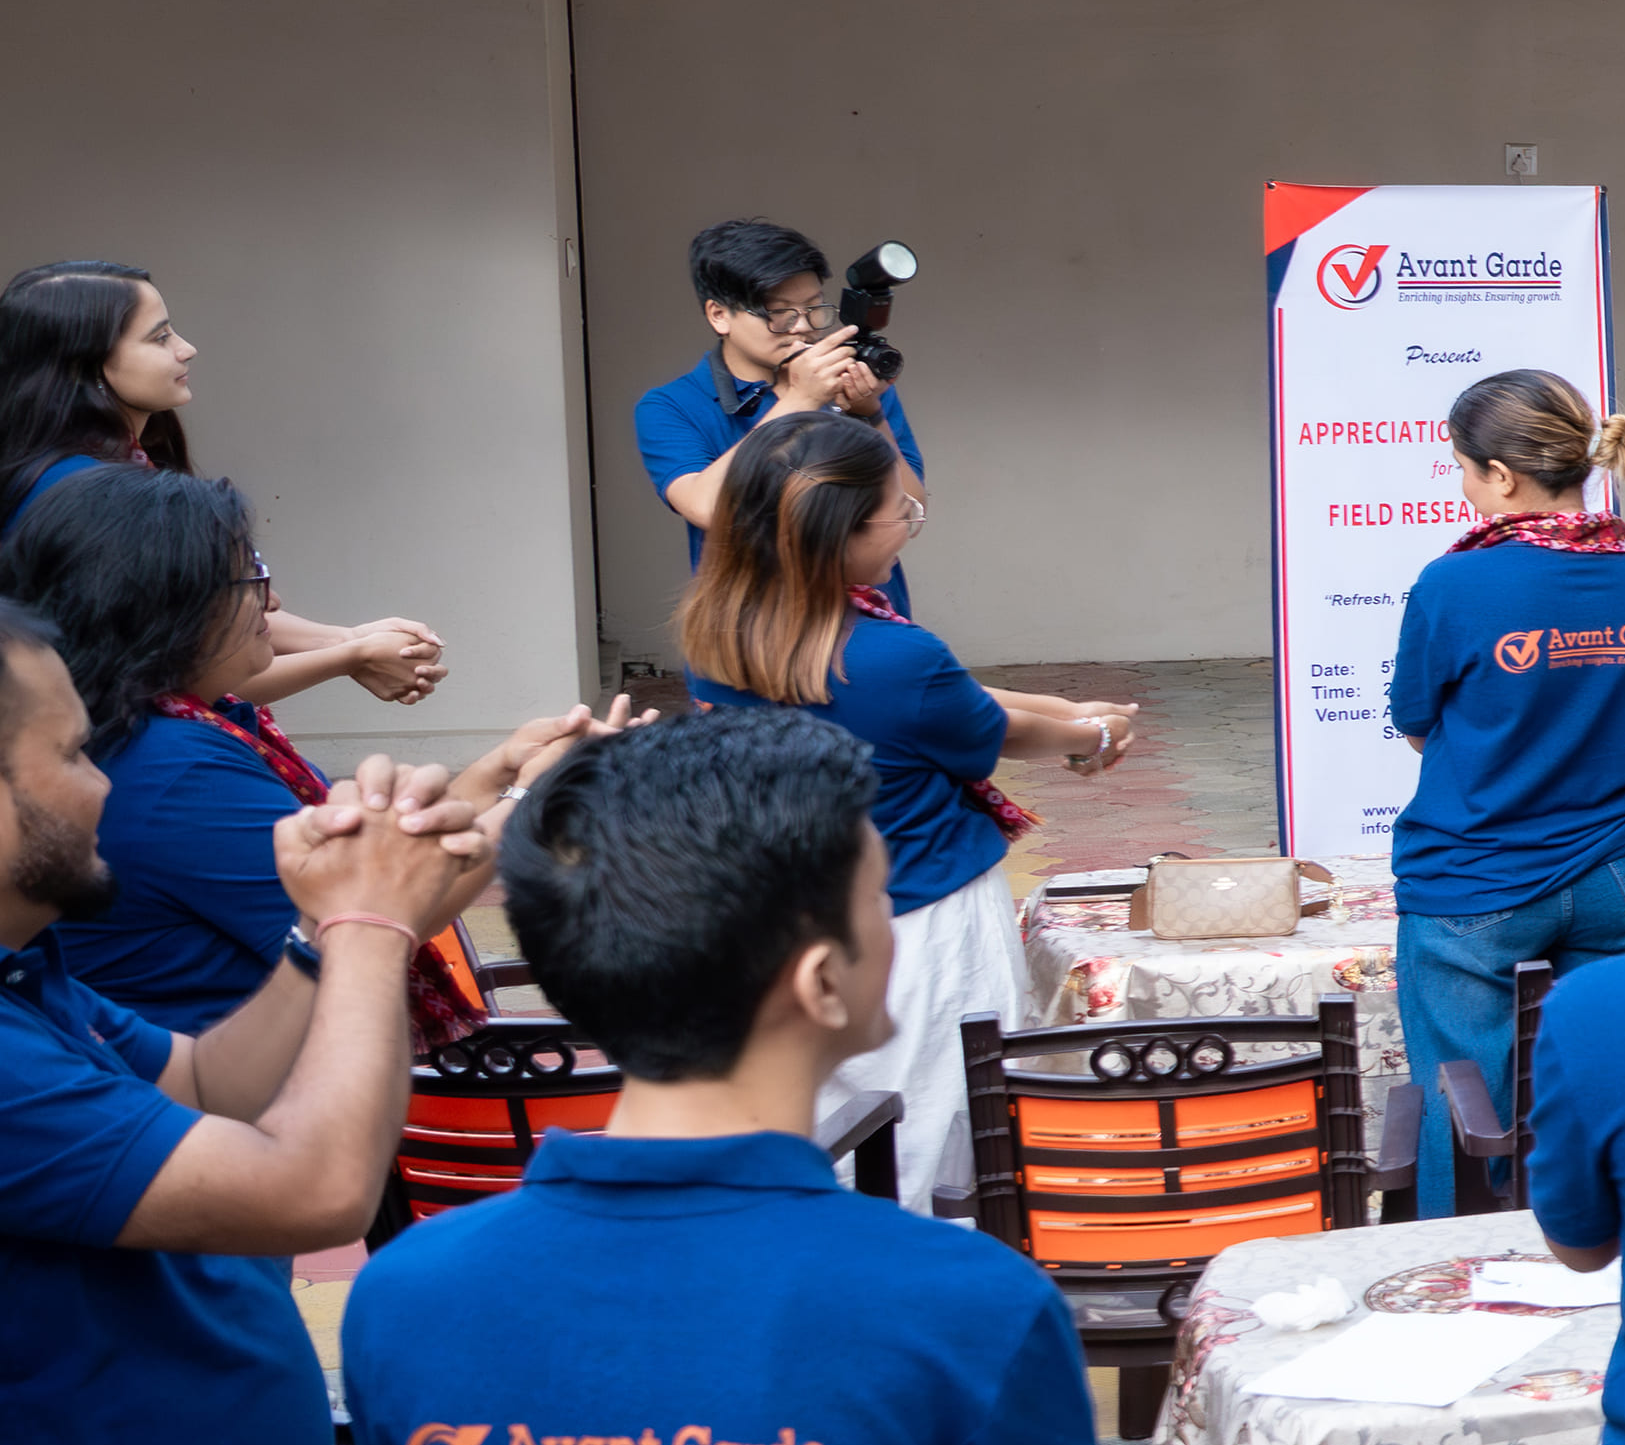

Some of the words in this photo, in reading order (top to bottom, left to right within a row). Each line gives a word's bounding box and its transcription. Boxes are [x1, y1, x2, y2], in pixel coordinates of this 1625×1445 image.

[1396, 252, 1478, 278] Avant
[1486, 252, 1562, 278] Garde
[1398, 292, 1443, 305] Enriching
[1444, 291, 1483, 305] insights.
[1485, 291, 1526, 304] Ensuring
[1526, 291, 1562, 305] growth.
[1405, 345, 1483, 366] Presents
[1299, 420, 1452, 445] APPRECIATIO
[1431, 460, 1453, 479] for
[1329, 503, 1393, 527] FIELD
[1402, 501, 1485, 525] RESEA
[1547, 626, 1615, 649] Avant
[1311, 664, 1356, 678] Date:
[1311, 685, 1361, 700] Time:
[1315, 707, 1377, 722] Venue:
